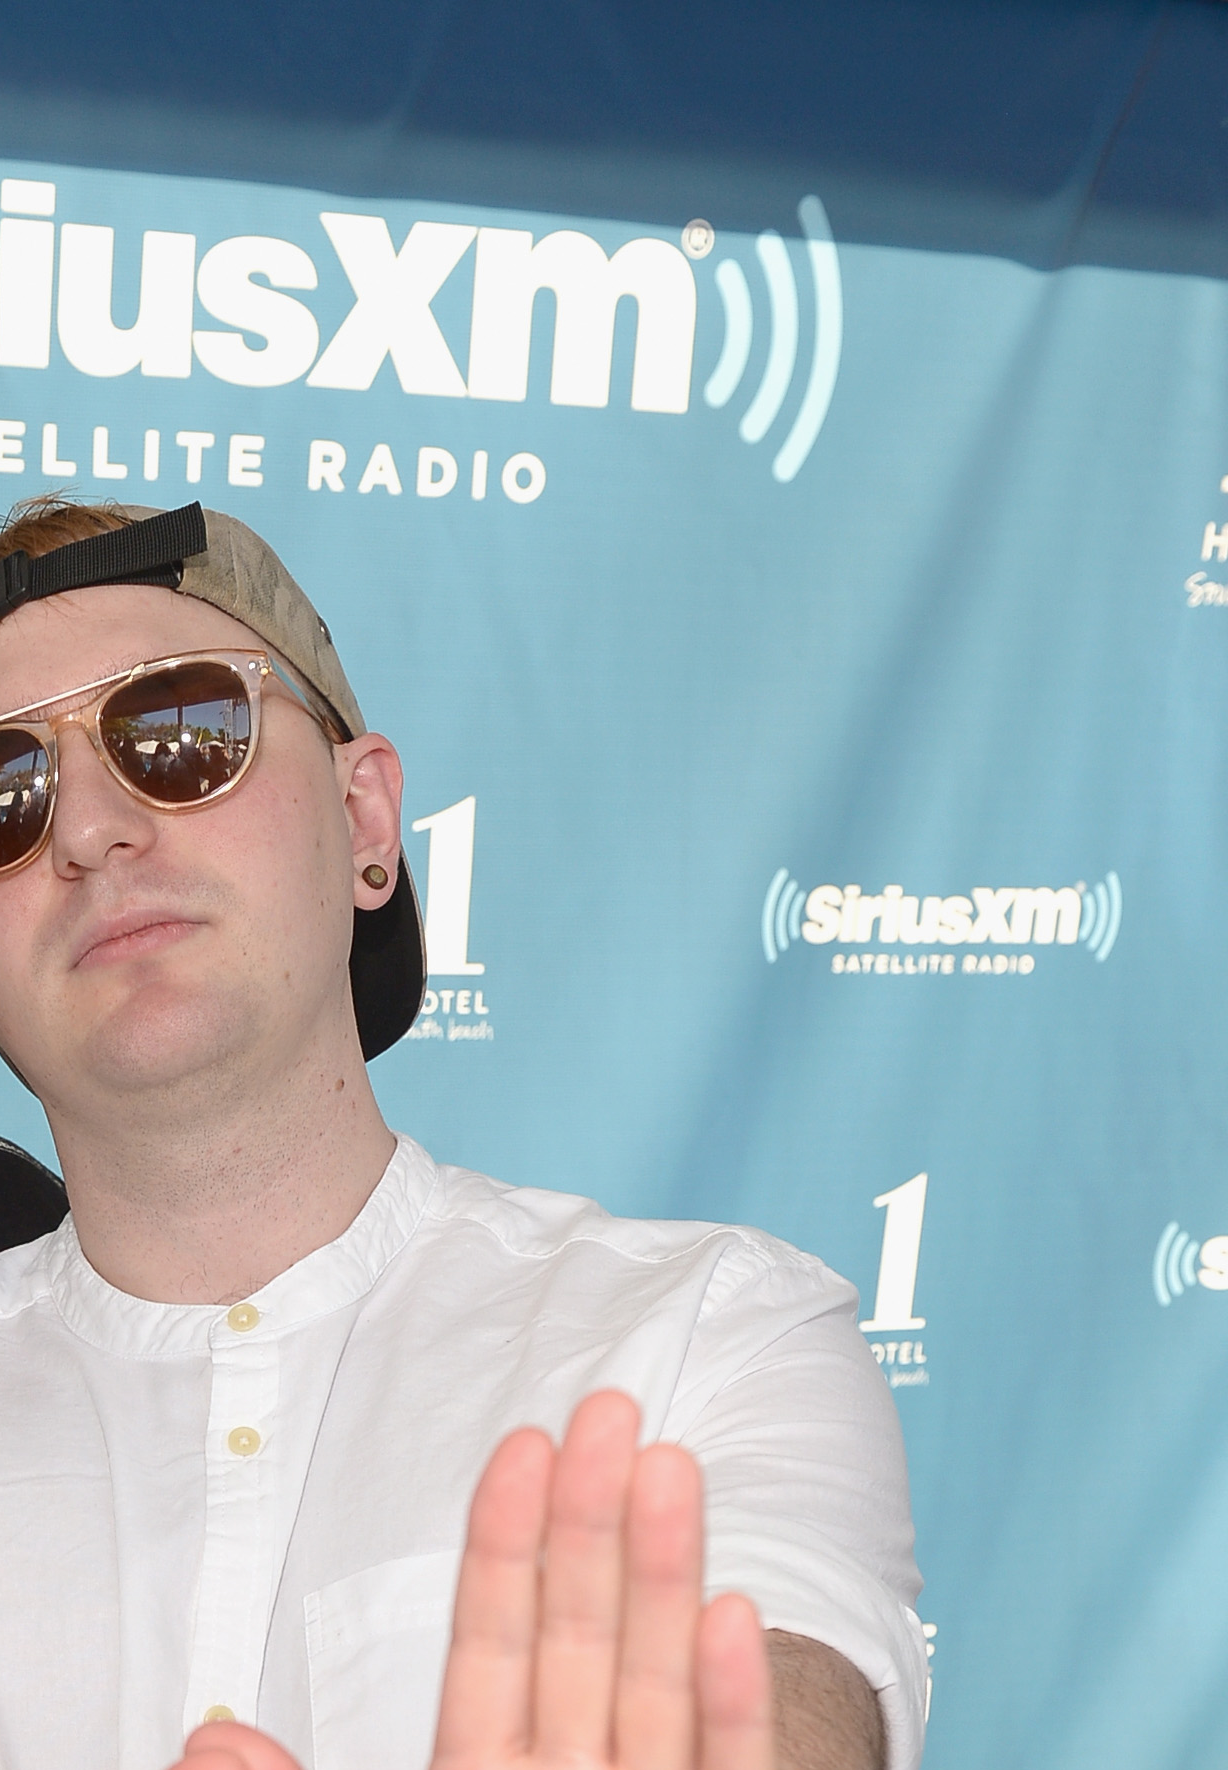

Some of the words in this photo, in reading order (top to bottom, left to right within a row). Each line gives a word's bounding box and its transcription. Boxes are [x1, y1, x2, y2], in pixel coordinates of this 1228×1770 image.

[307, 439, 547, 504] RADIO
[832, 953, 955, 975] SATELLITE
[962, 953, 1035, 975] RADIO
[860, 1172, 928, 1333] 1
